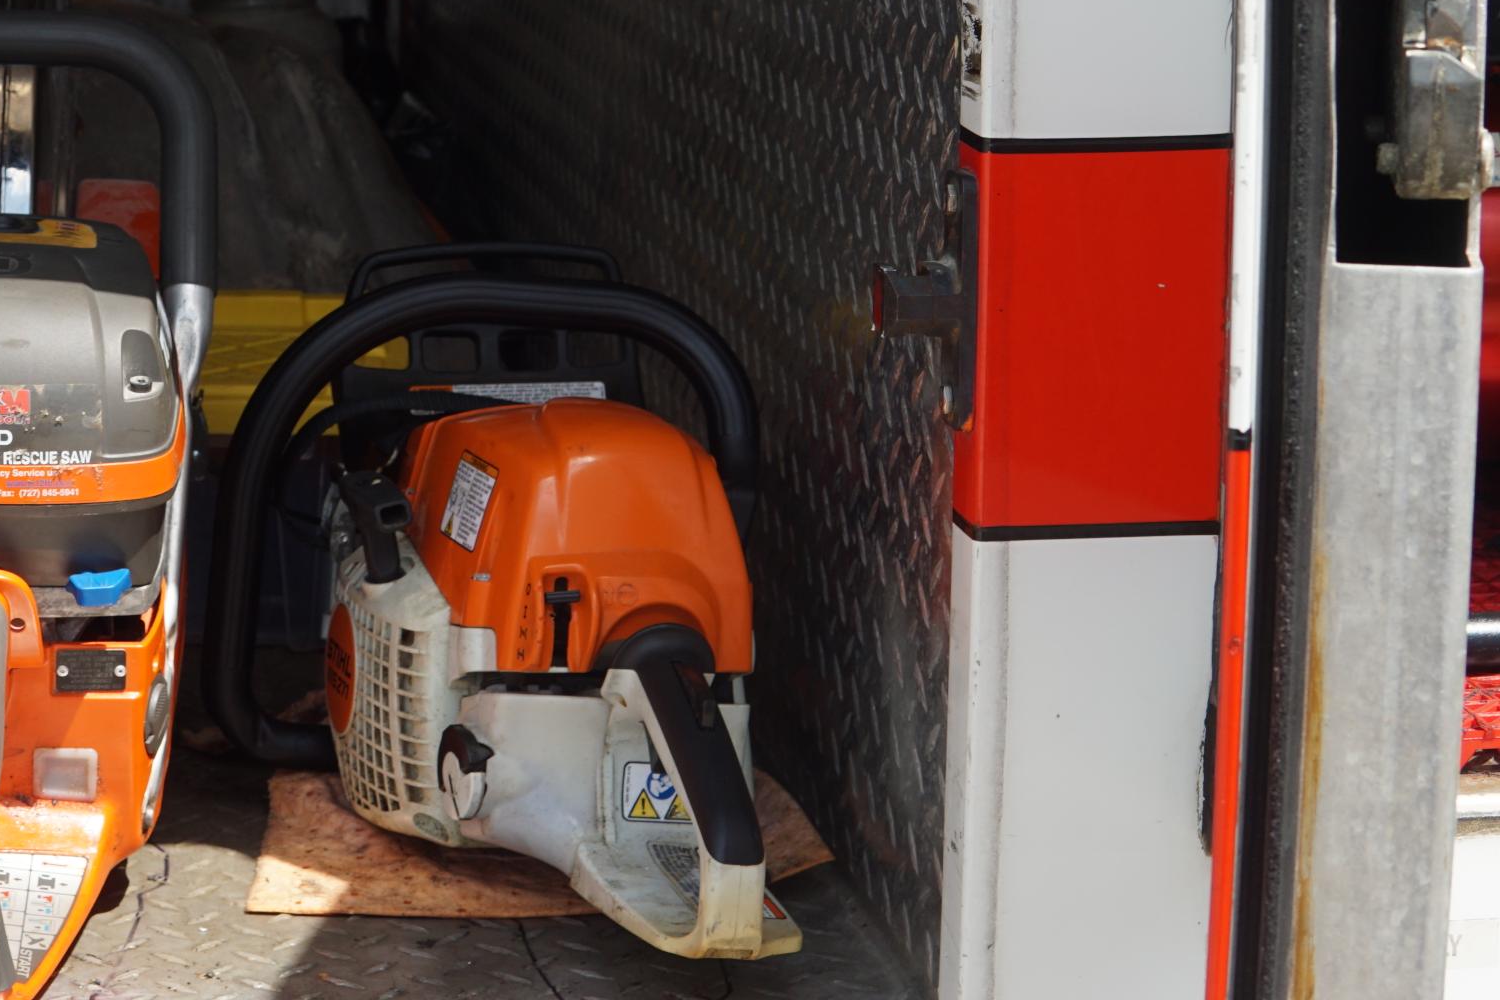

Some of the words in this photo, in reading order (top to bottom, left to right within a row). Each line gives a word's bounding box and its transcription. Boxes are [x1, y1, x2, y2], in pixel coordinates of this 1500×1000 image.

[3, 451, 58, 465] RESCUE
[60, 450, 93, 465] SAW
[12, 468, 46, 478] Service
[19, 488, 41, 498] (727)
[326, 637, 352, 680] STIHL
[16, 947, 34, 979] START
